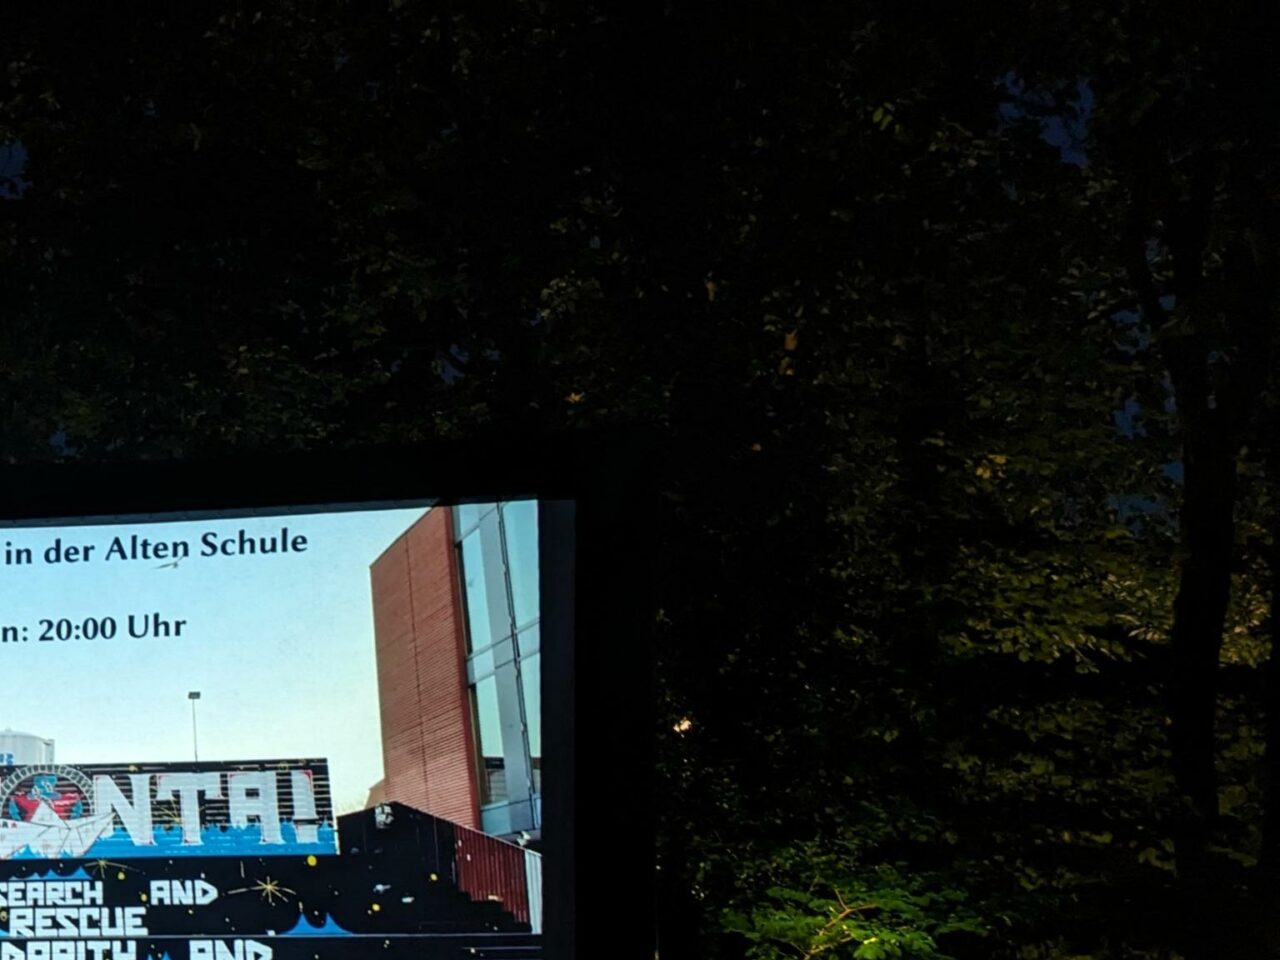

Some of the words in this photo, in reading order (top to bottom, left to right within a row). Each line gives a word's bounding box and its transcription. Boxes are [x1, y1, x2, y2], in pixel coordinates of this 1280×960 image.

[5, 541, 33, 566] in
[43, 539, 95, 564] der
[104, 535, 190, 561] Alten
[200, 528, 309, 558] Schule
[38, 617, 117, 642] 20:00
[127, 613, 187, 639] Uhr
[150, 880, 218, 905] AND
[8, 907, 149, 938] RESCUE
